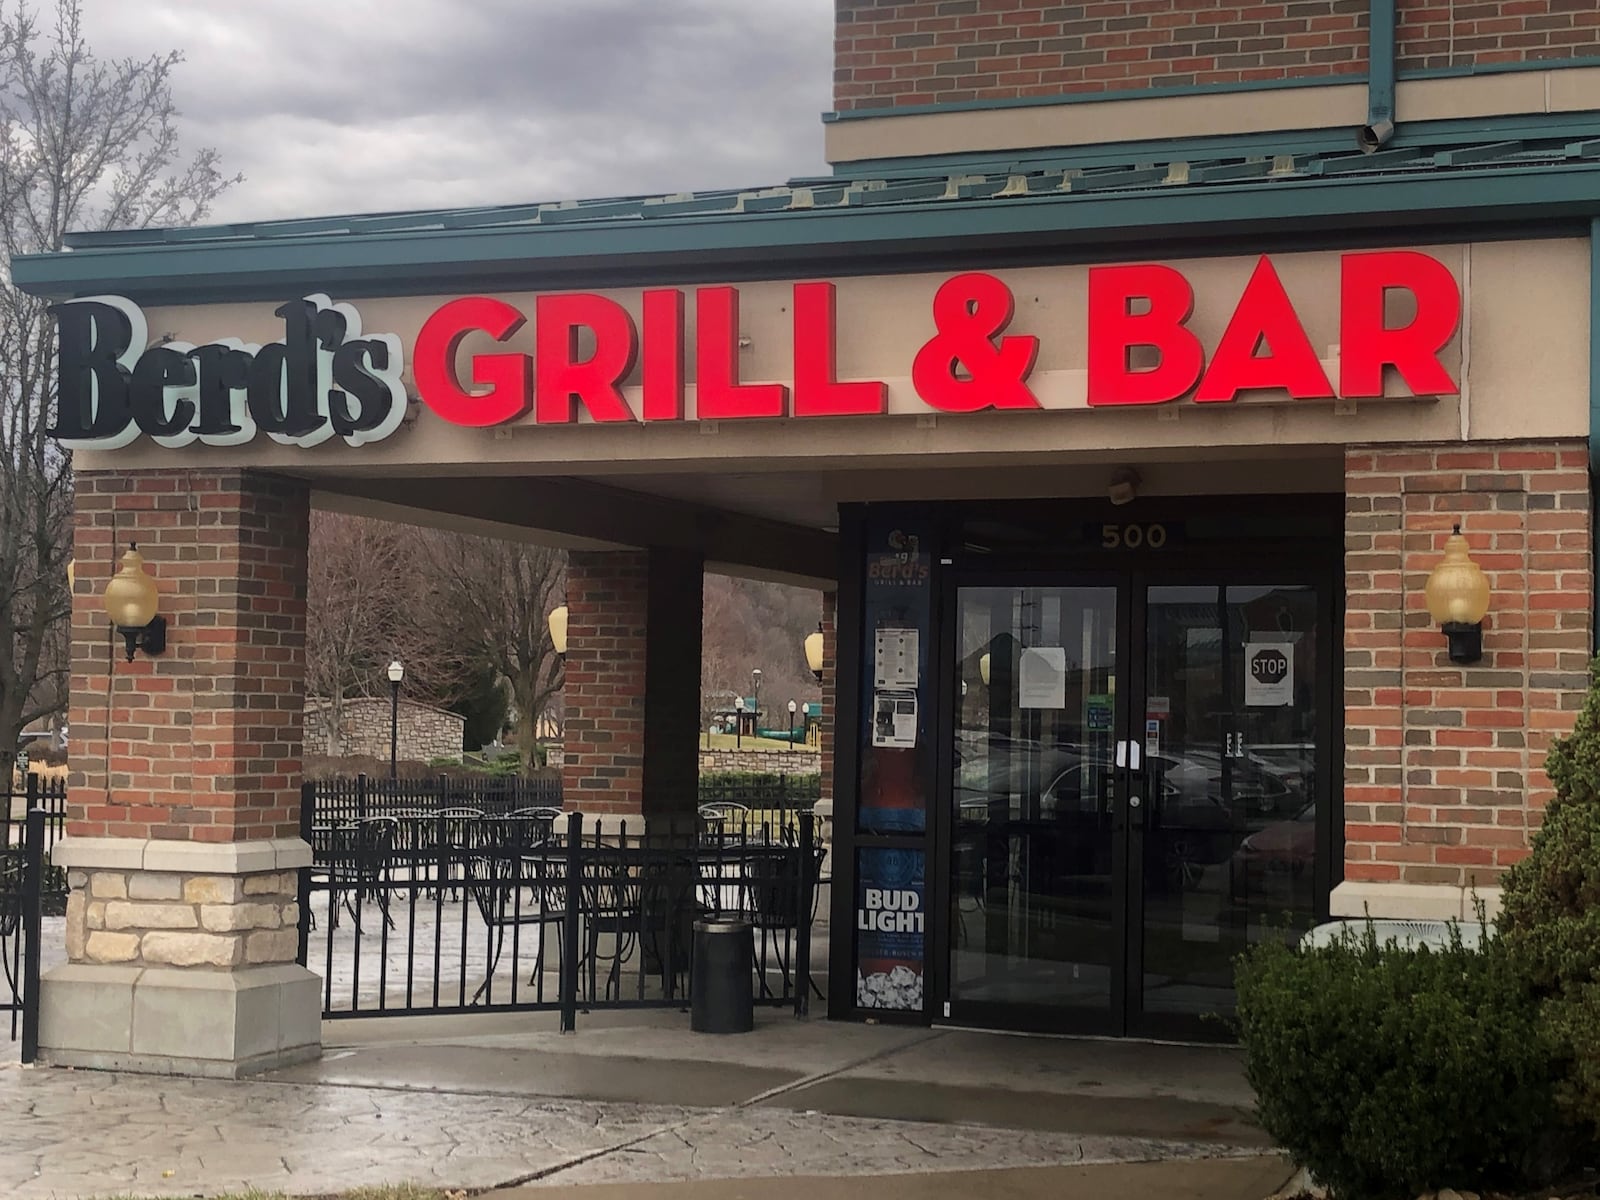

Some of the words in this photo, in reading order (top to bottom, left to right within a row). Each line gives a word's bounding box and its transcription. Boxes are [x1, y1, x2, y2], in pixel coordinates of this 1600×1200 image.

[45, 297, 396, 441] Berd's
[412, 282, 888, 428] GRILL
[912, 272, 1044, 413] &
[1088, 250, 1461, 408] BAR
[1102, 524, 1167, 549] 500
[1252, 658, 1287, 675] STOP
[865, 888, 920, 911] BUD
